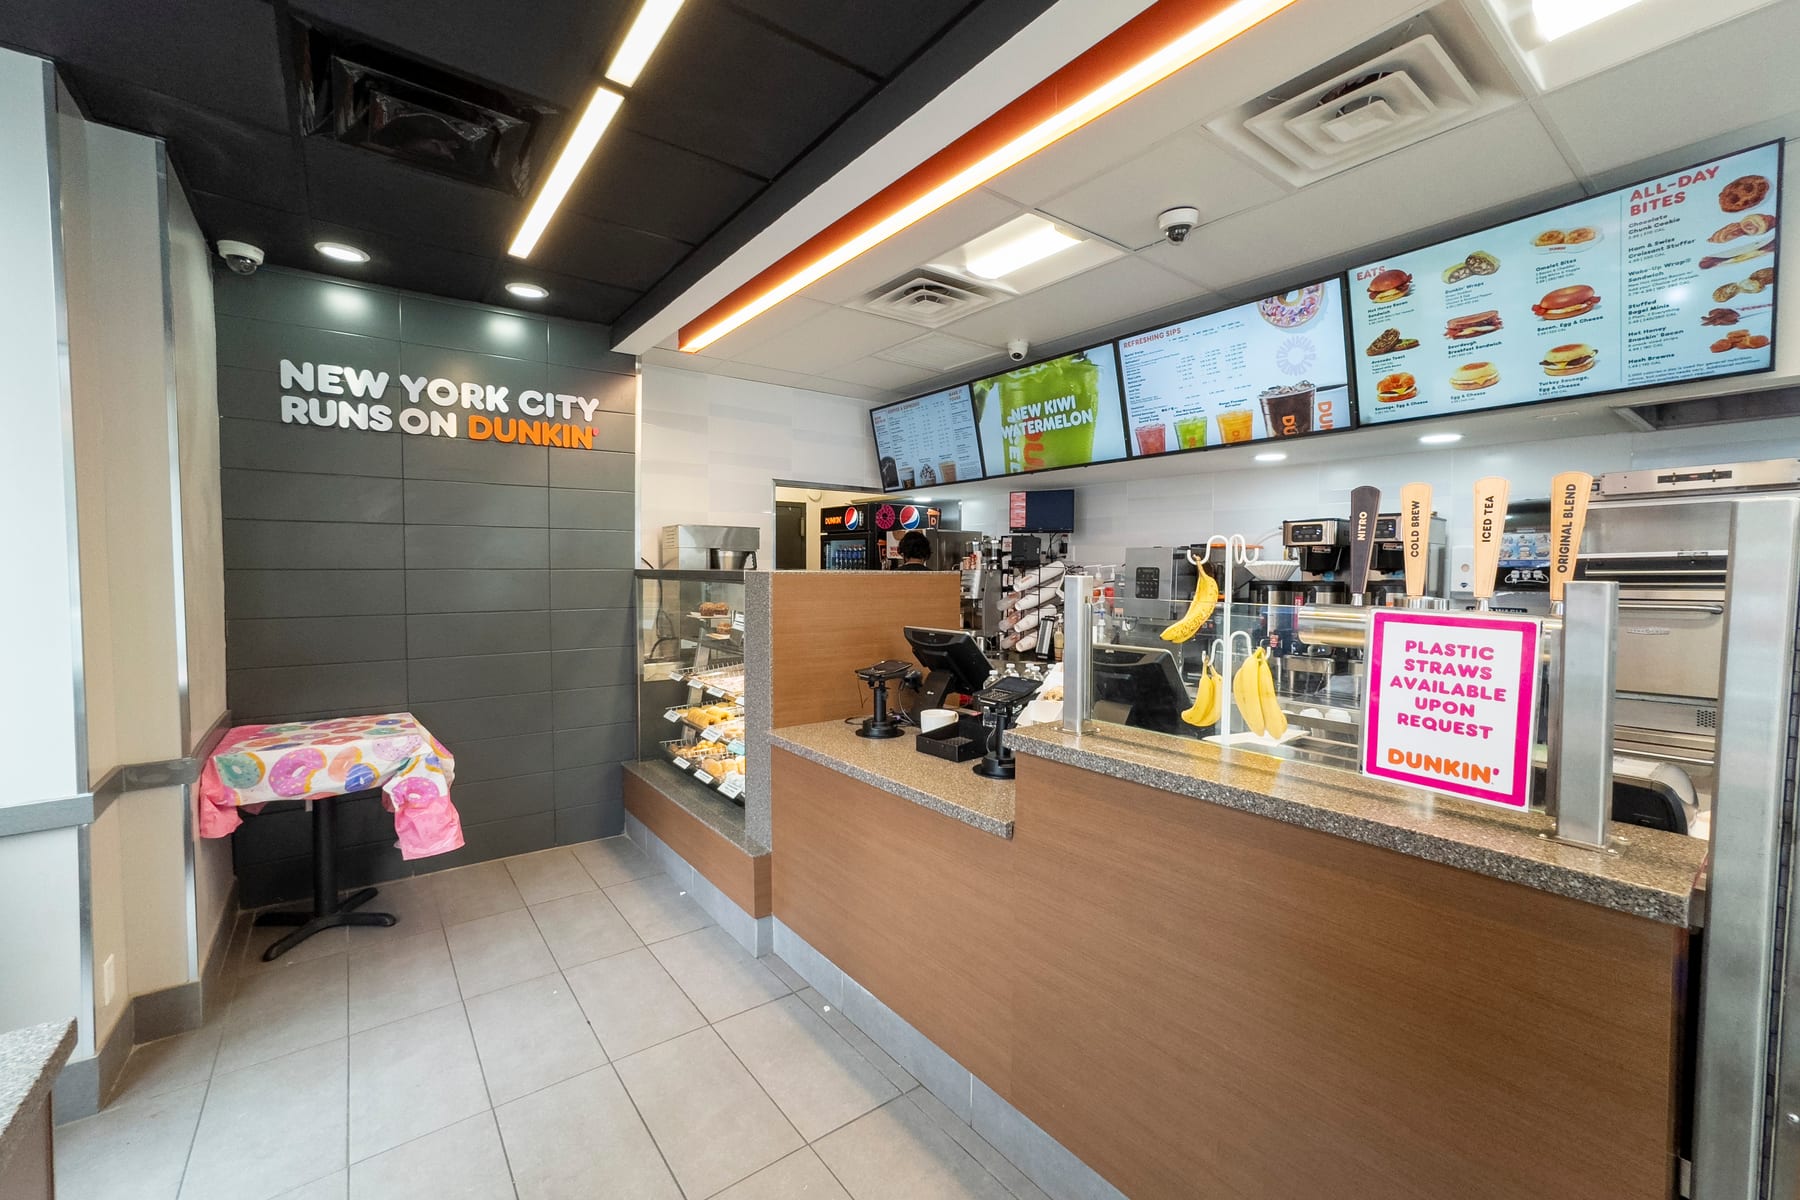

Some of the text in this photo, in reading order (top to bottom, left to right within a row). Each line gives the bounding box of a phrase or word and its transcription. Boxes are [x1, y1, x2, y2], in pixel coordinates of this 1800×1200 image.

[1630, 166, 1720, 202] ALL-DAY
[1630, 191, 1686, 216] BITES
[1628, 215, 1668, 228] Chocolate
[1628, 225, 1652, 235] Chunk
[1653, 217, 1681, 228] Cookie
[1628, 245, 1646, 253] Ham
[1654, 237, 1676, 246] Swiss
[1356, 266, 1386, 281] EATS
[1536, 258, 1577, 272] Omelet Bites
[1628, 265, 1662, 277] Wake-Up
[1628, 271, 1665, 283] Sandwich
[1628, 299, 1657, 309] Stuffed
[1628, 303, 1670, 316] Bagel Minis
[1580, 316, 1603, 324] Cheese
[1643, 326, 1668, 335] Honey
[1123, 332, 1165, 349] REFRESHING
[1165, 327, 1182, 338] SIPS
[1660, 329, 1685, 338] Bacon
[1628, 353, 1675, 365] Hash Browns
[280, 359, 600, 422] NEW YORK CITY
[1011, 395, 1076, 420] NEW KIWI
[281, 395, 600, 449] RUNS ON DUNKIN'
[1001, 408, 1093, 439] WATERMELON
[1357, 511, 1368, 541] NITRO
[1410, 500, 1420, 558] COLD BREW
[1482, 495, 1495, 543] ICED TEA
[1557, 484, 1577, 573] ORIGINAL BLEND
[1405, 640, 1494, 661] PLASTIC
[1404, 658, 1493, 680] STRAWS
[1390, 675, 1507, 702] AVAILABLE
[1414, 697, 1475, 717] UPON
[1397, 712, 1493, 740] REQUEST
[1387, 748, 1500, 784] DUNKIN'
